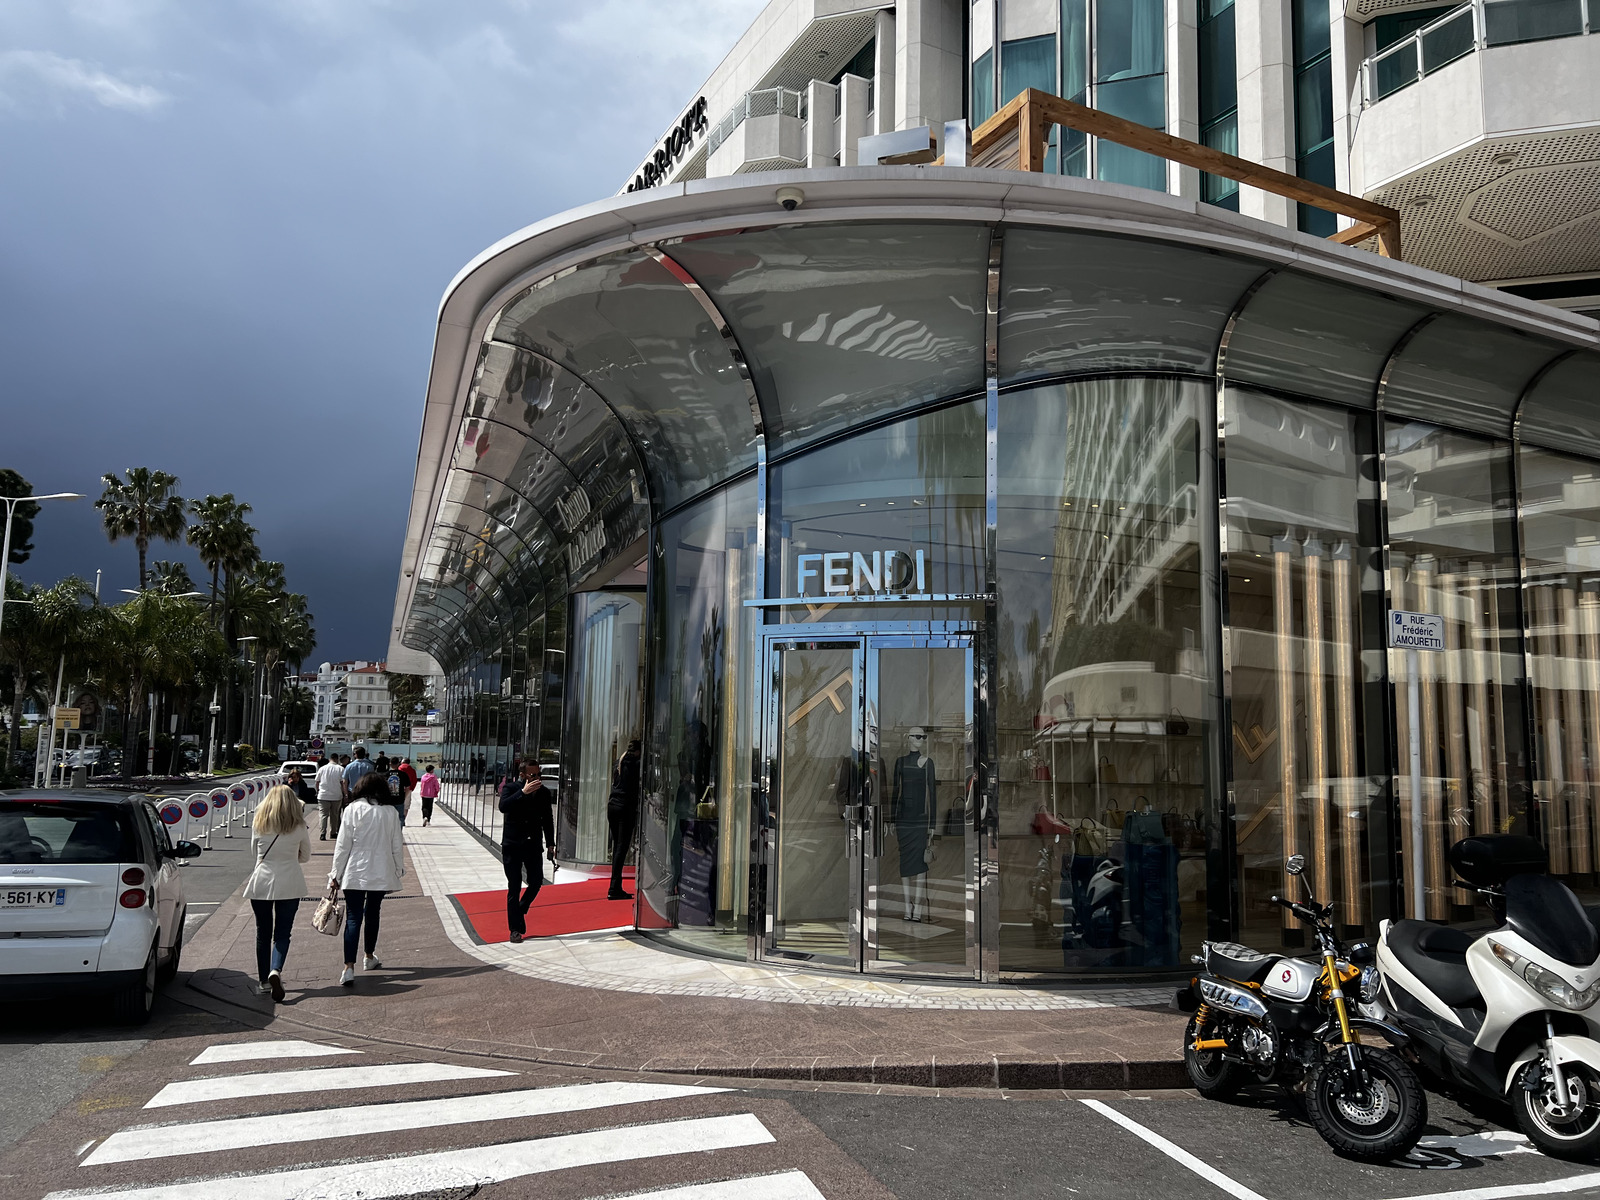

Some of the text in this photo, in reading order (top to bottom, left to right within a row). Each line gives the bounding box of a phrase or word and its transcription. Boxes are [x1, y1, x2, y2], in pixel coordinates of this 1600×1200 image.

[622, 96, 705, 194] ARRIOTT
[798, 549, 925, 593] FENDI
[1410, 616, 1425, 625] RUE
[1402, 625, 1434, 636] Frédéric
[1396, 635, 1441, 648] AMOURETTI
[0, 891, 56, 904] -561-KY
